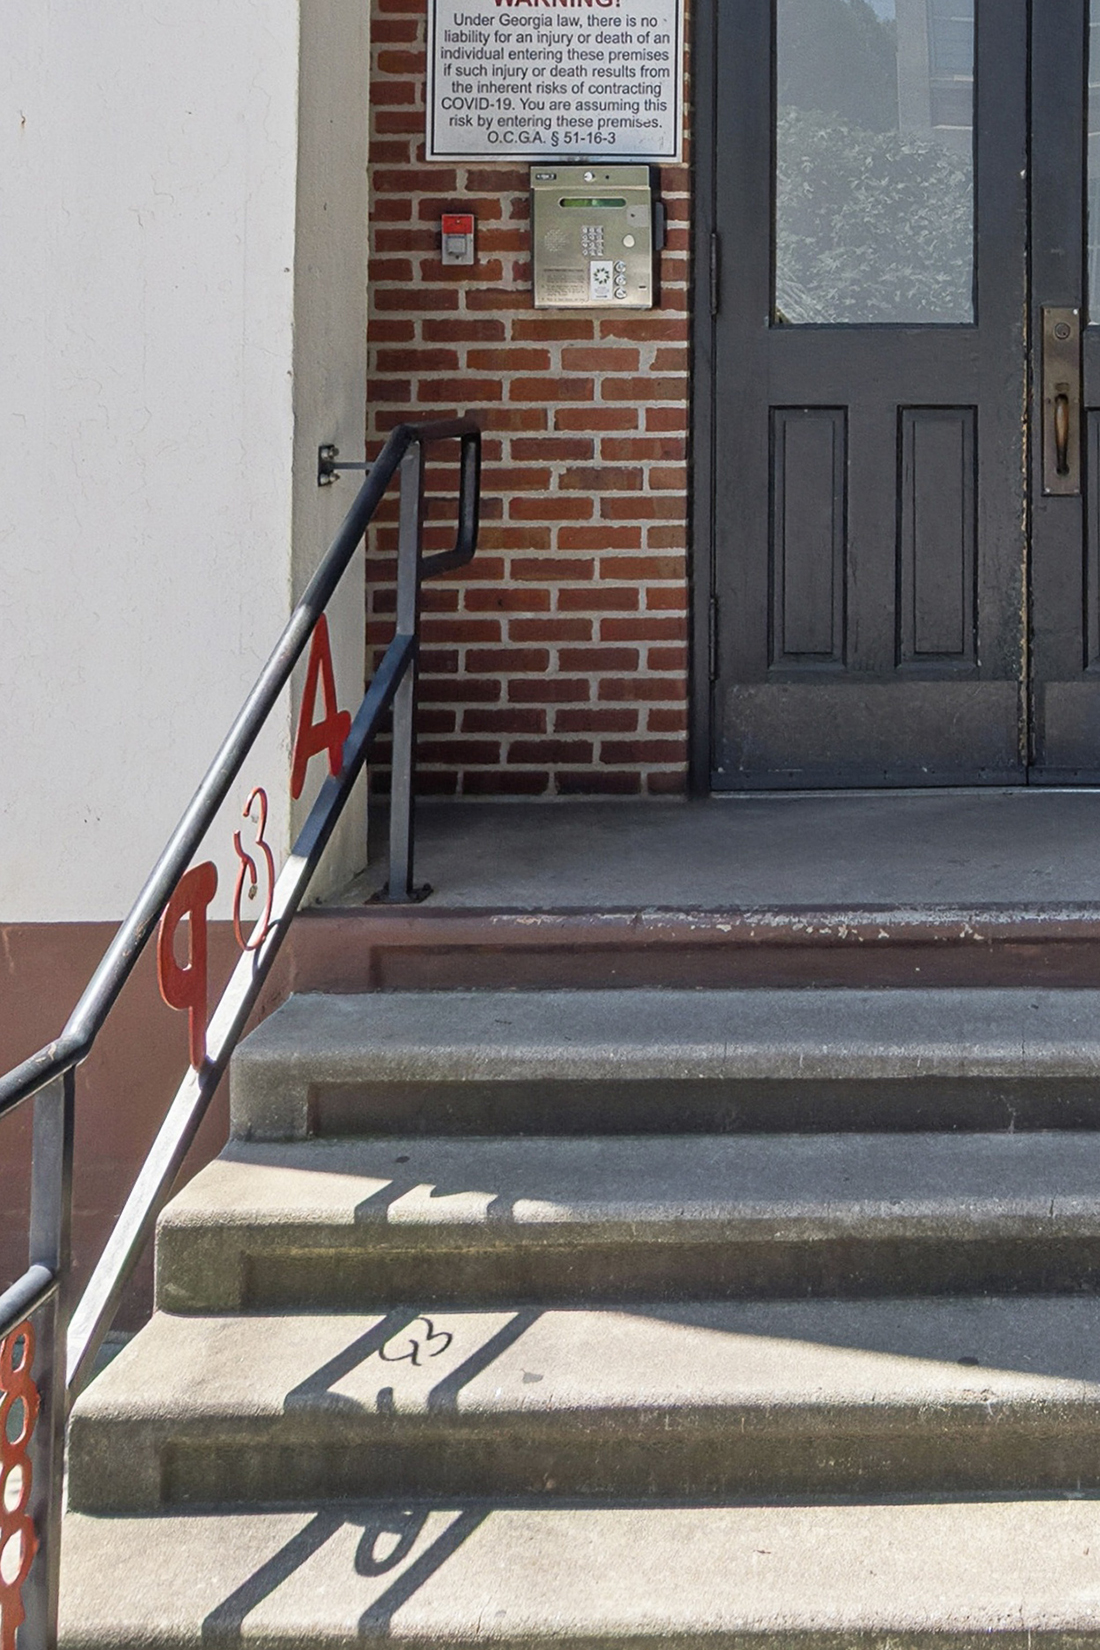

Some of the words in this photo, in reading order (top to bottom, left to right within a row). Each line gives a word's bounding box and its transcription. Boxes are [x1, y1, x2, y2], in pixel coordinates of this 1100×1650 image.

[453, 13, 495, 26] Under
[499, 13, 553, 30] Georgia
[557, 14, 583, 29] law,
[587, 14, 622, 28] there
[626, 14, 637, 28] is
[641, 17, 658, 28] no
[444, 30, 490, 47] liability
[494, 30, 512, 44] for
[516, 33, 533, 43] an
[537, 31, 574, 47] injury
[577, 33, 592, 44] or
[595, 31, 633, 44] death
[637, 31, 651, 44] of
[653, 34, 670, 44] an
[441, 47, 504, 60] individual
[508, 48, 563, 64] entering
[567, 48, 604, 61] these
[608, 48, 670, 64] premises
[443, 63, 452, 76] if
[455, 64, 488, 77] such
[492, 64, 529, 80] injury
[532, 67, 546, 77] or
[550, 65, 588, 78] death
[592, 65, 636, 78] results
[640, 65, 670, 78] from
[452, 81, 473, 94] the
[477, 81, 532, 94] inherent
[536, 81, 567, 94] risks
[571, 81, 585, 95] of
[588, 82, 662, 98] contracting
[441, 97, 516, 110] COVID-19.
[520, 98, 545, 111] You
[549, 100, 571, 111] are
[575, 98, 640, 115] assuming
[644, 99, 668, 112] this
[449, 114, 473, 127] risk
[477, 114, 493, 130] by
[497, 115, 552, 130] entering
[556, 115, 594, 128] these
[598, 115, 663, 131] premises.
[487, 131, 547, 144] O.C.G.A.
[563, 132, 616, 144] 51-16-3
